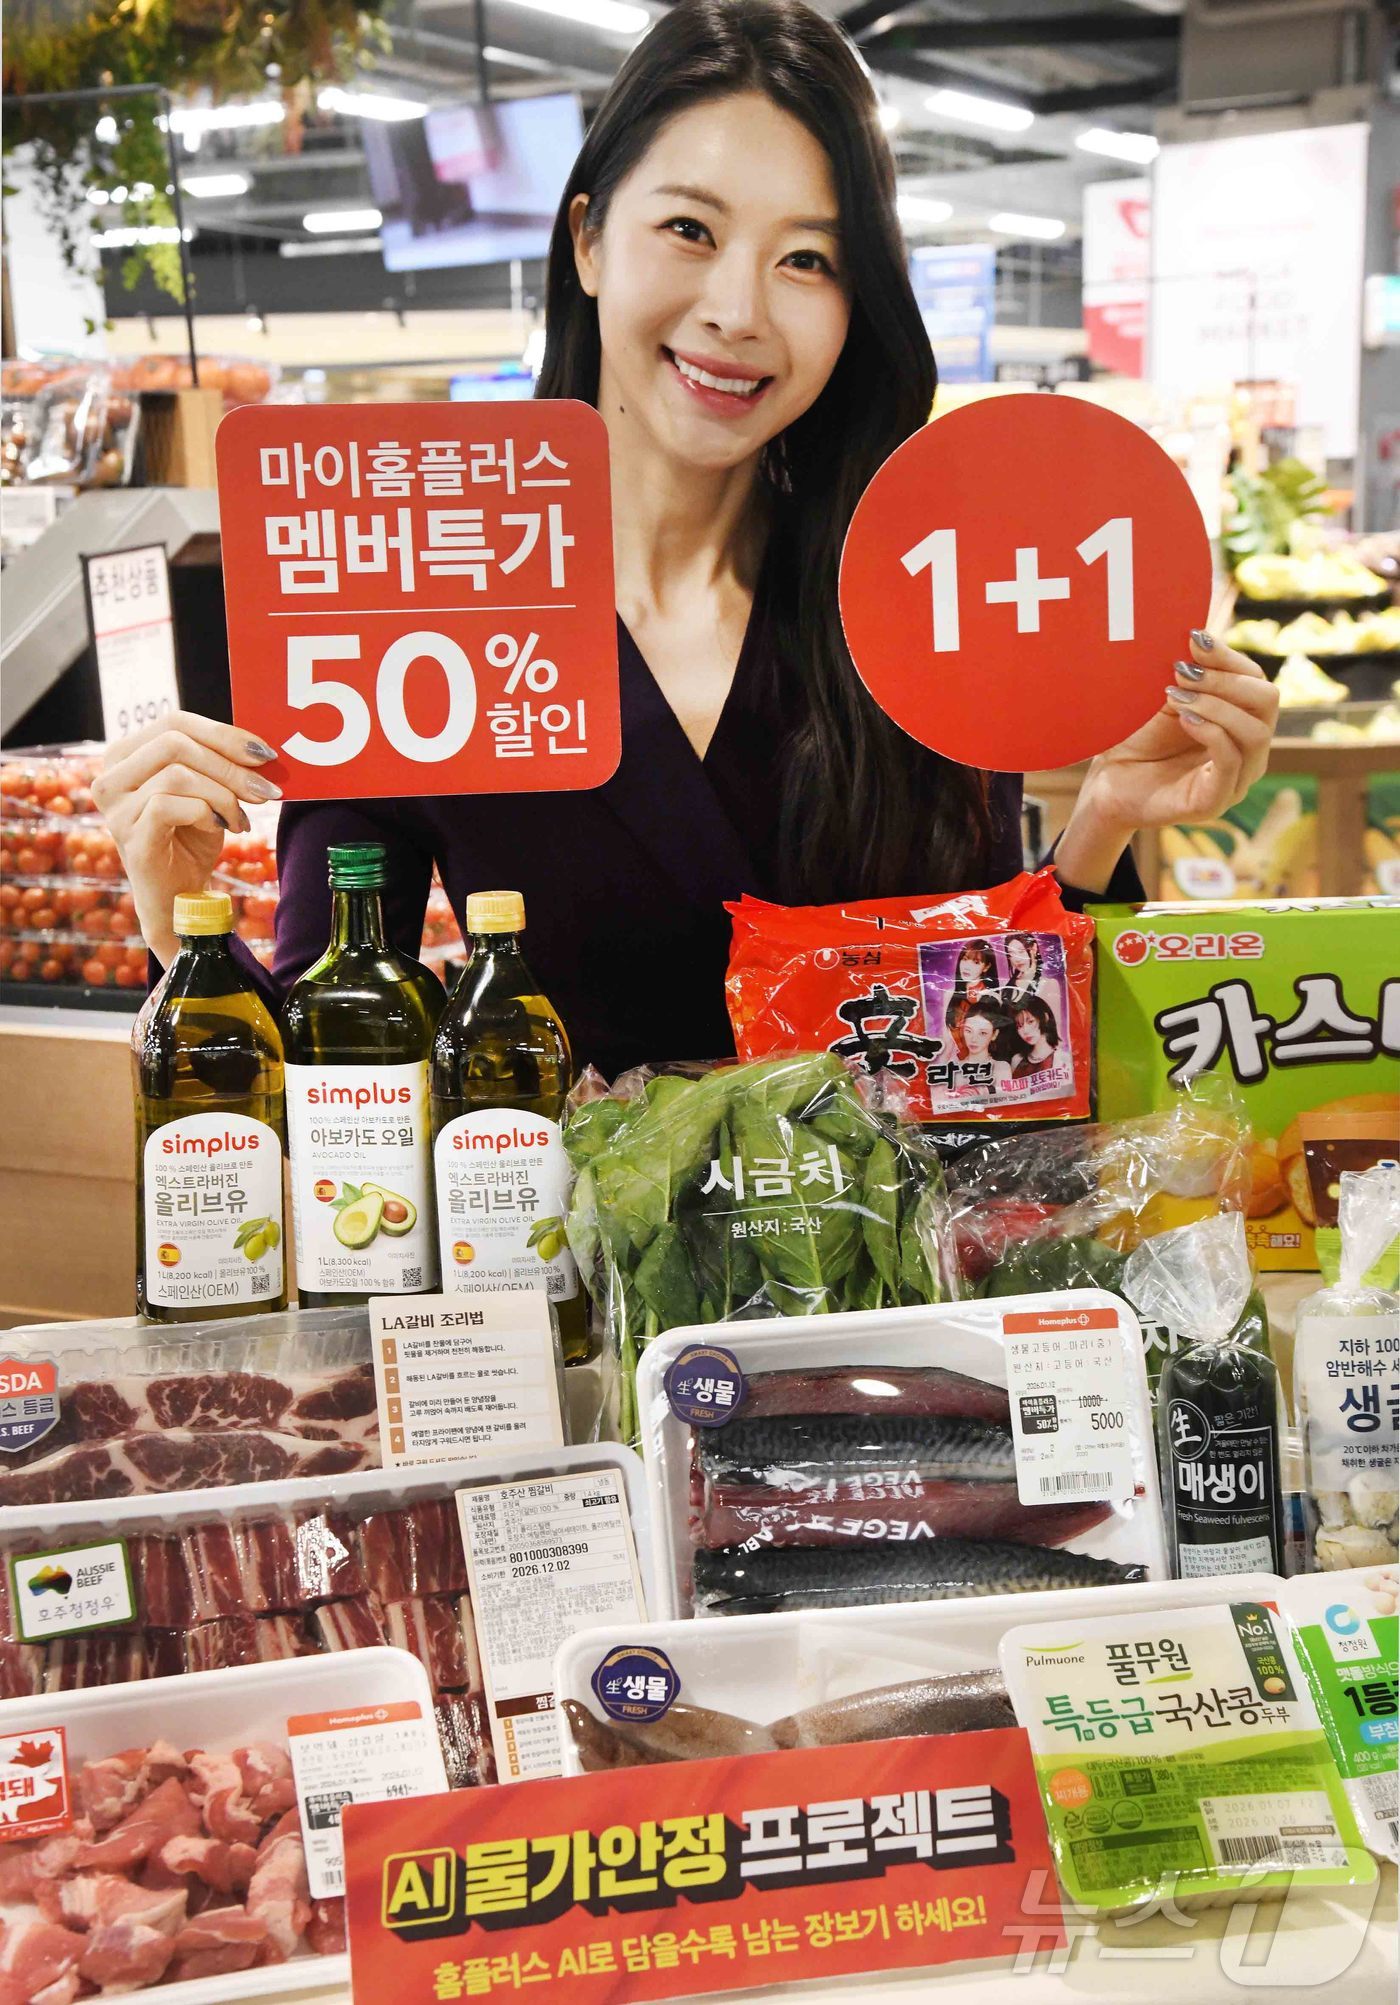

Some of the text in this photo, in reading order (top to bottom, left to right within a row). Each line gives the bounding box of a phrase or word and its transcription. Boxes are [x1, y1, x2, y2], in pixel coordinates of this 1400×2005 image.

[260, 438, 571, 499] 마이홈플러스
[265, 504, 575, 594] 멤버특가
[901, 517, 1135, 653] 1+1
[486, 700, 588, 758] 할인
[1156, 933, 1263, 959] 오리온
[842, 950, 881, 966] 농심
[1156, 974, 1399, 1085] 카스
[927, 1061, 994, 1092] 라면
[308, 1082, 411, 1110] simplus
[163, 1132, 260, 1158] simplus
[311, 1127, 414, 1147] 아보카도 오일
[453, 1128, 549, 1154] simplus
[312, 1151, 367, 1159] AVOCADO OIL
[156, 1173, 239, 1191] 엑스트라버진
[448, 1170, 529, 1188] 엑스트라버진
[700, 1145, 845, 1201] 시금치
[154, 1190, 249, 1217] 올리브유
[448, 1187, 540, 1214] 올리브유
[156, 1219, 178, 1228] EXTRA
[179, 1219, 206, 1228] VIRGIN
[207, 1217, 230, 1226] OLIVE
[450, 1215, 536, 1225] EXTRA VIRGIN OLIVE OIL
[158, 1284, 240, 1301] 스페인산(OEM)
[382, 1311, 484, 1331] LA갈비 조리법
[1038, 1316, 1078, 1327] Homeplus
[403, 1340, 431, 1349] LA갈비를
[432, 1339, 451, 1348] 찬물에
[1339, 1338, 1371, 1356] 지하
[427, 1371, 455, 1381] LA갈비를
[1326, 1360, 1387, 1378] 암반해수
[0, 1371, 43, 1394] SDA
[693, 1377, 736, 1406] 생물
[23, 1398, 54, 1415] 등급
[690, 1407, 715, 1419] FRESH
[11, 1424, 35, 1436] BEEF
[1090, 1411, 1124, 1431] 5000
[1170, 1407, 1202, 1447] 生
[500, 1488, 526, 1501] 호주산
[528, 1483, 554, 1497] 찜갈비
[1178, 1461, 1265, 1504] 매생이
[1194, 1513, 1231, 1525] Seaweed
[1231, 1513, 1270, 1525] fulvescens
[509, 1542, 589, 1564] 801000308399
[76, 1562, 116, 1578] AUSSIE
[512, 1560, 571, 1579] 2026.12.02
[76, 1575, 104, 1588] BEEF
[38, 1597, 116, 1622] 호주청정우
[1237, 1619, 1274, 1638] No.1
[1338, 1639, 1369, 1653] 청정원
[1026, 1655, 1085, 1667] Pulmuone
[1105, 1638, 1192, 1686] 풀무원
[1256, 1655, 1278, 1665] 국산콩
[1256, 1665, 1285, 1675] 100%
[622, 1675, 669, 1702] 생물
[1343, 1680, 1399, 1717] 1등
[622, 1705, 648, 1715] FRESH
[1042, 1686, 1291, 1742] 특등급 국산콩 두부
[387, 1857, 447, 1914] AI
[465, 1813, 727, 1916] 물가안정
[740, 1784, 998, 1878] 프로젝트
[433, 1894, 988, 2001] 홈플러스 AI로 담을수록 남는 장보기 하세요!
